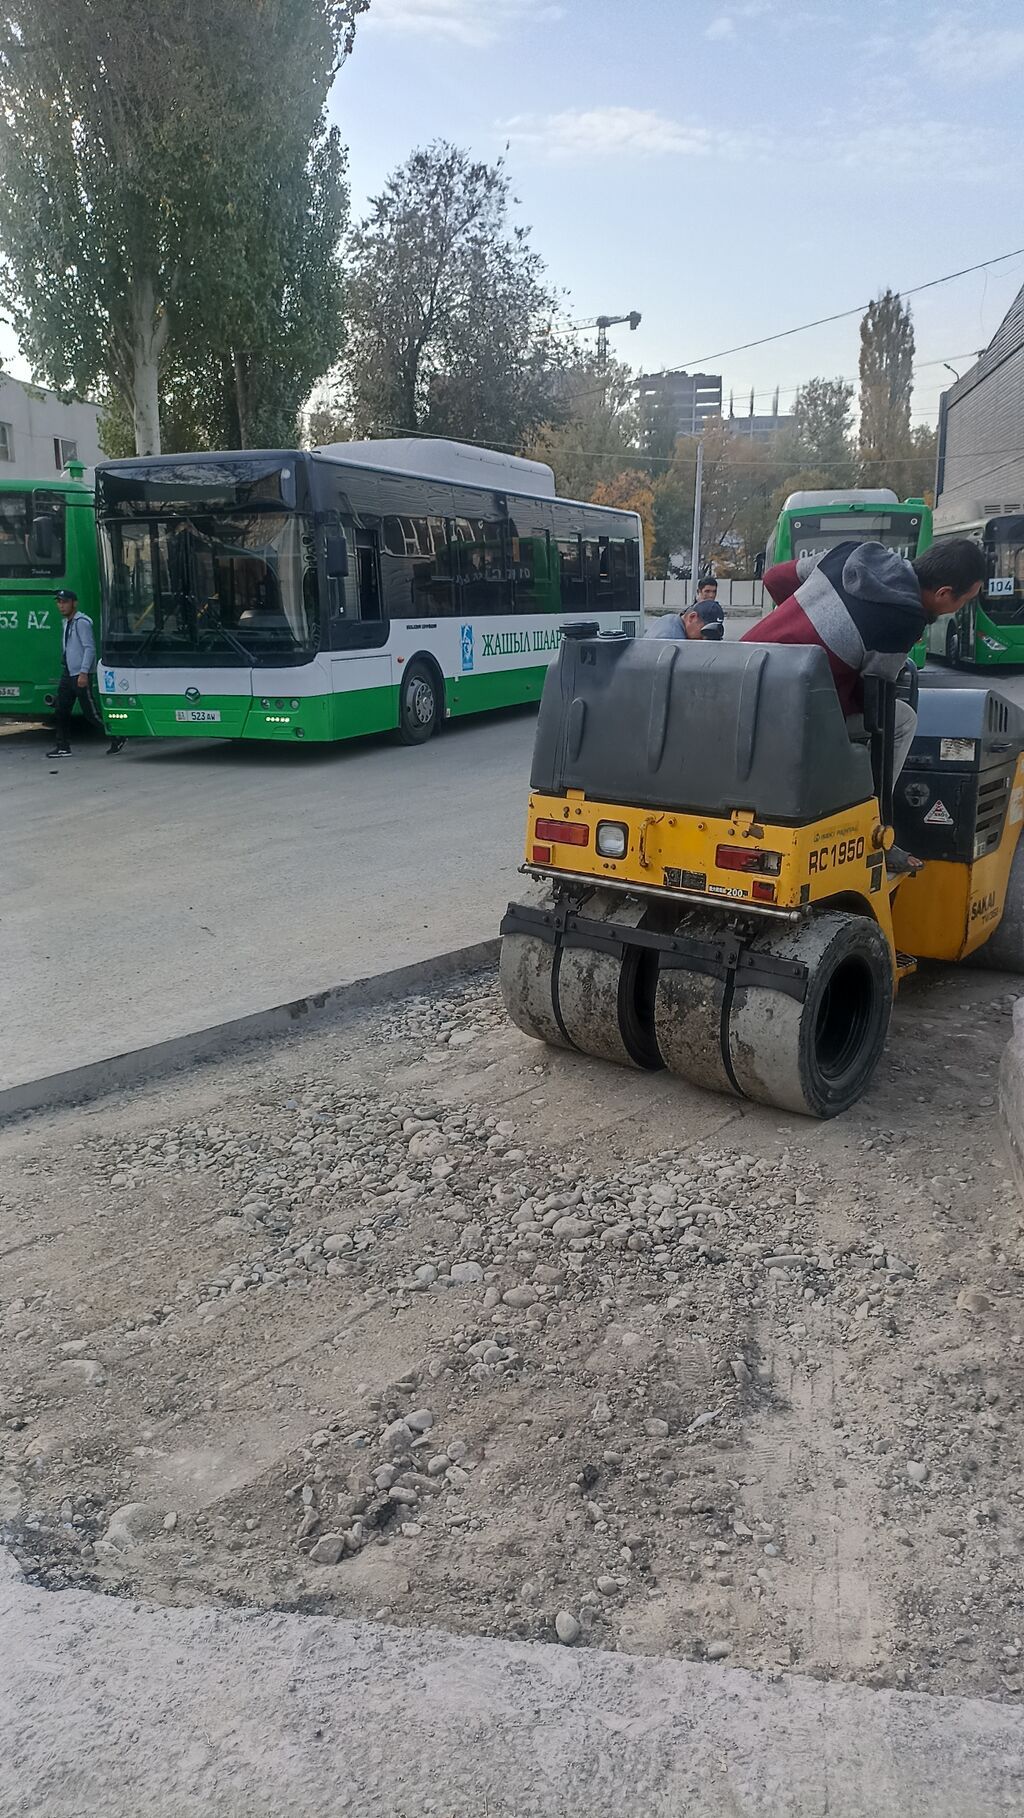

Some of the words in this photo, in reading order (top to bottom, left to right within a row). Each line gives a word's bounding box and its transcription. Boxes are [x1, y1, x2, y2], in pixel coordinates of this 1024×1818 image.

[990, 581, 1012, 593] 104
[27, 610, 51, 629] AZ
[481, 630, 531, 657] ЖАШЫЛ
[191, 711, 205, 721] 523
[726, 888, 743, 898] 200
[971, 890, 995, 921] SAKAI
